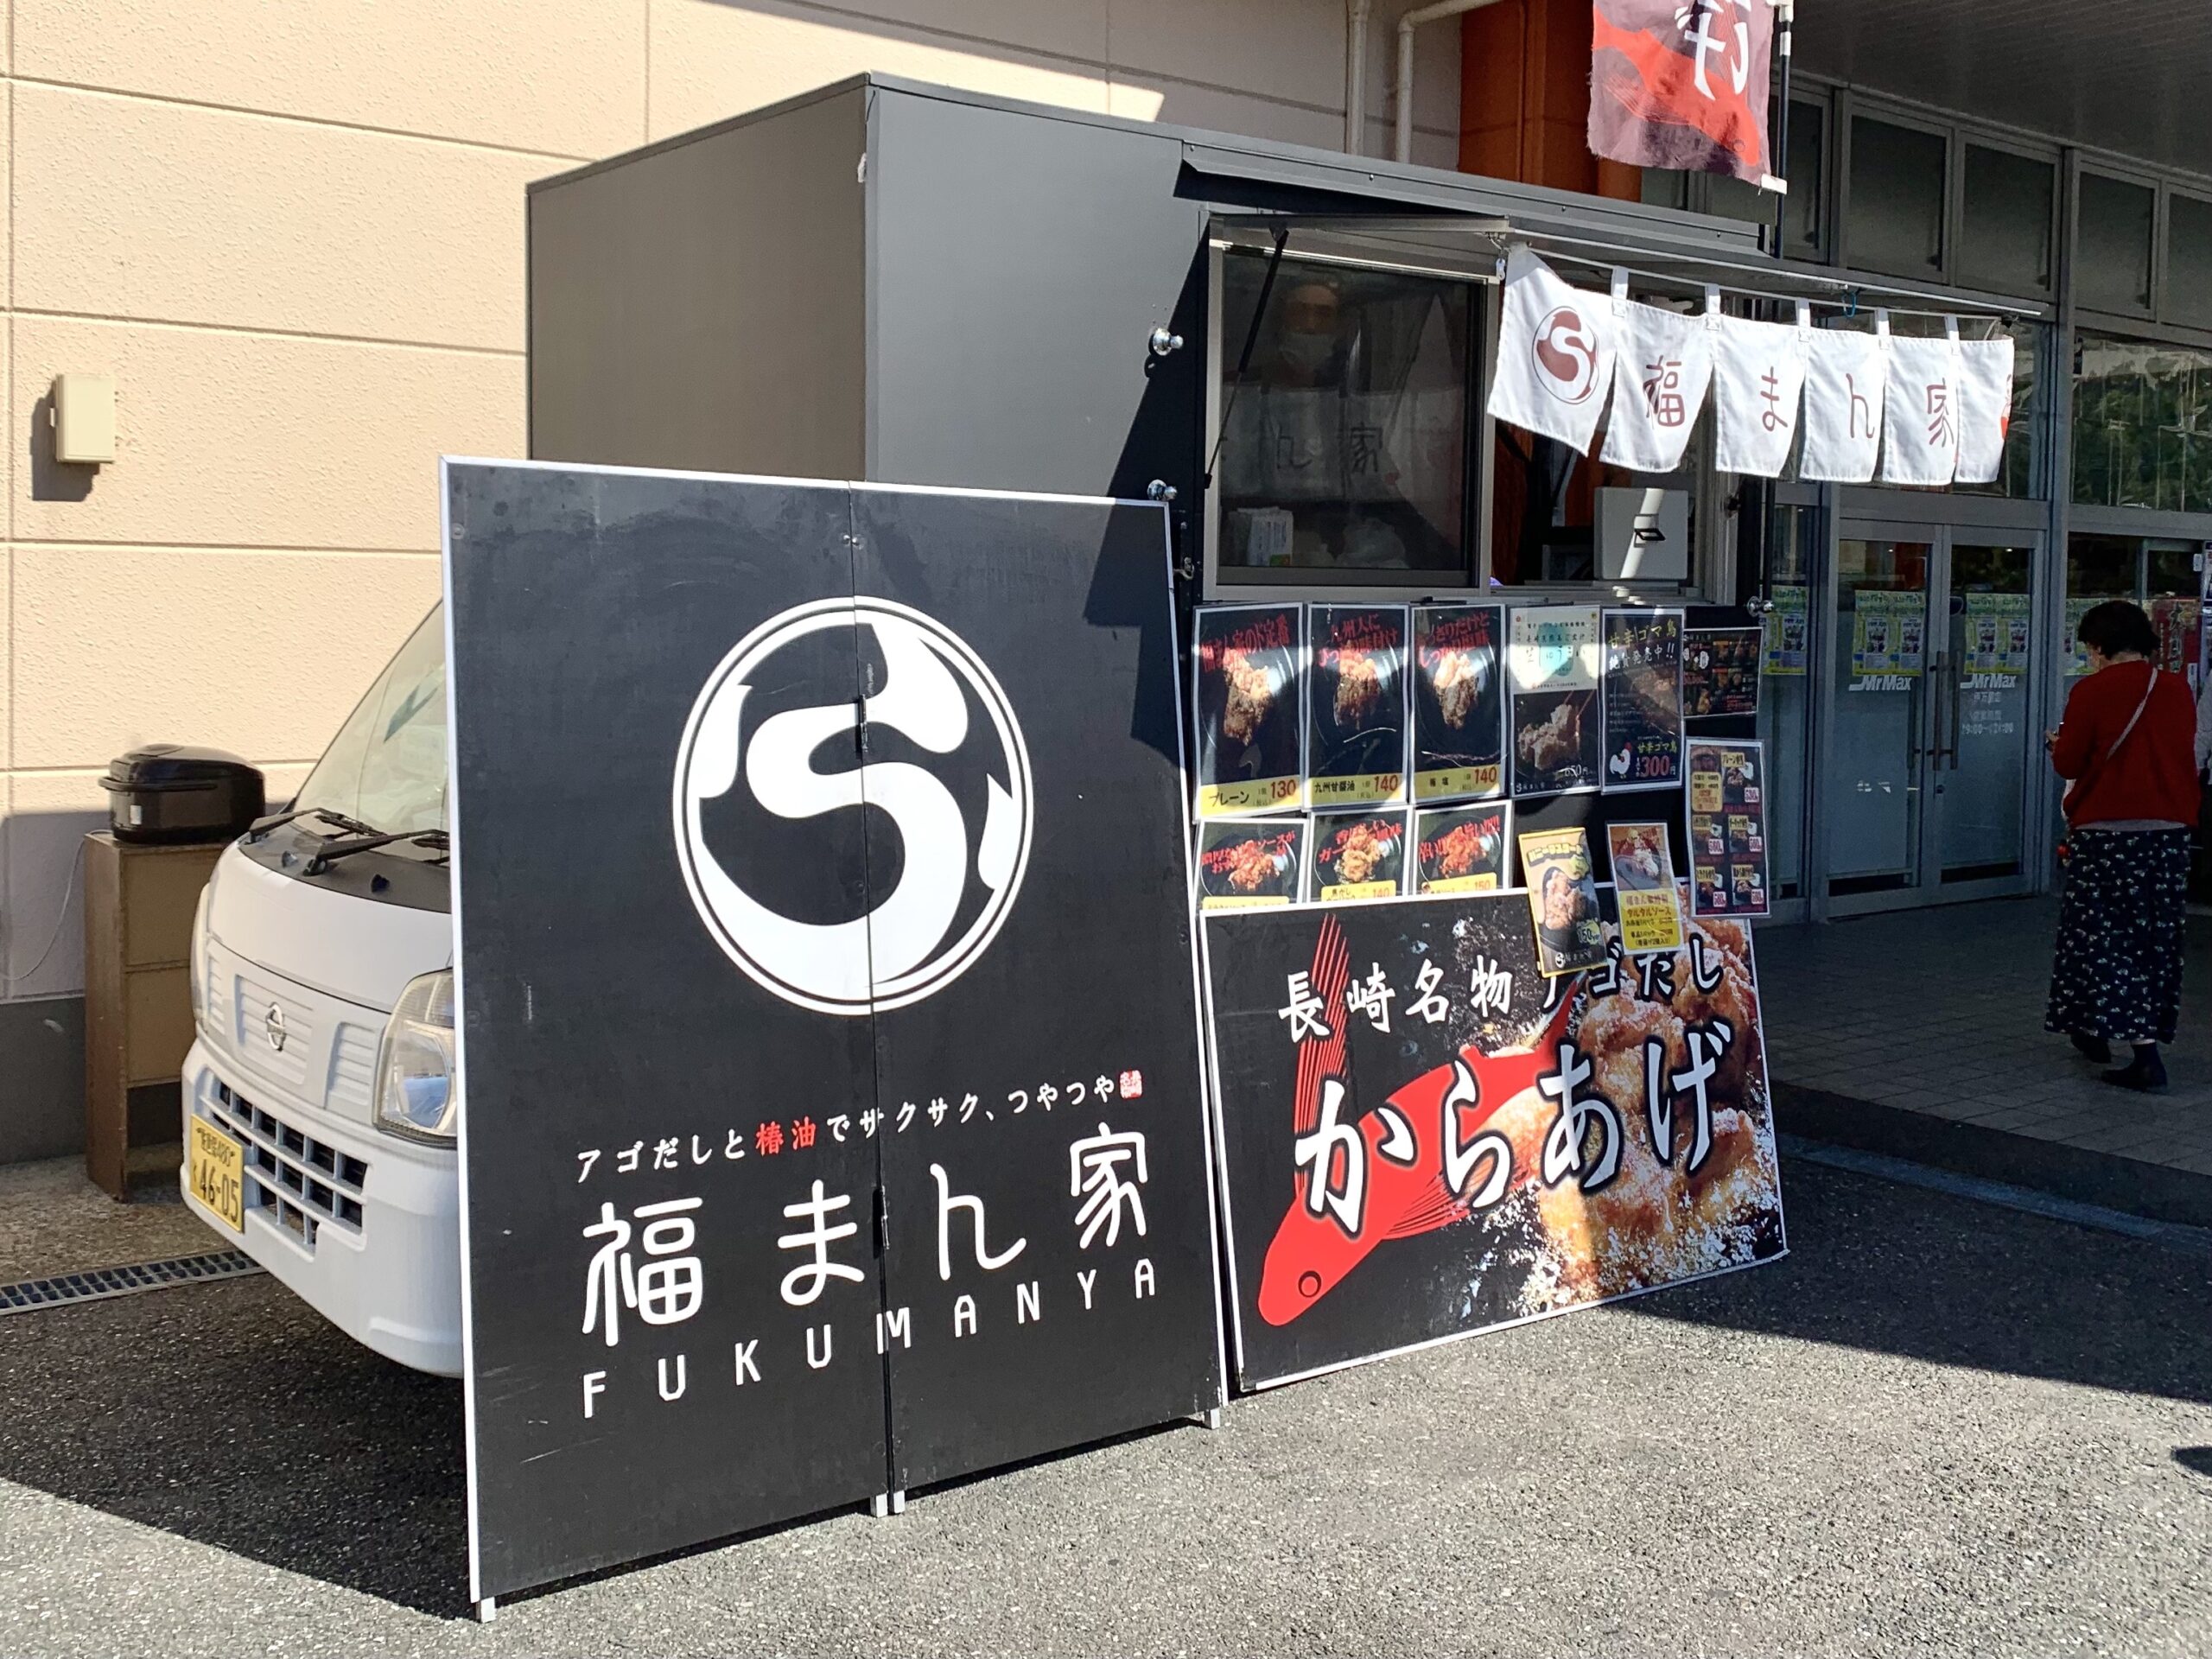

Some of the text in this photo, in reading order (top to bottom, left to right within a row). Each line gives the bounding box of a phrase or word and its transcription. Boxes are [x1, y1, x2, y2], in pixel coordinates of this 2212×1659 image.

[1643, 354, 1955, 448] 福まん家
[1849, 674, 1912, 691] MrMax
[1961, 672, 2017, 689] MrMax
[1374, 775, 1398, 792] 140
[1474, 766, 1497, 785] 140
[1271, 779, 1296, 799] 130
[1627, 906, 1672, 918] タルタルソース
[1295, 1020, 1731, 1234] からあげ
[582, 1122, 1148, 1347] 福まん家
[583, 1257, 1155, 1419] FUKUMANYA
